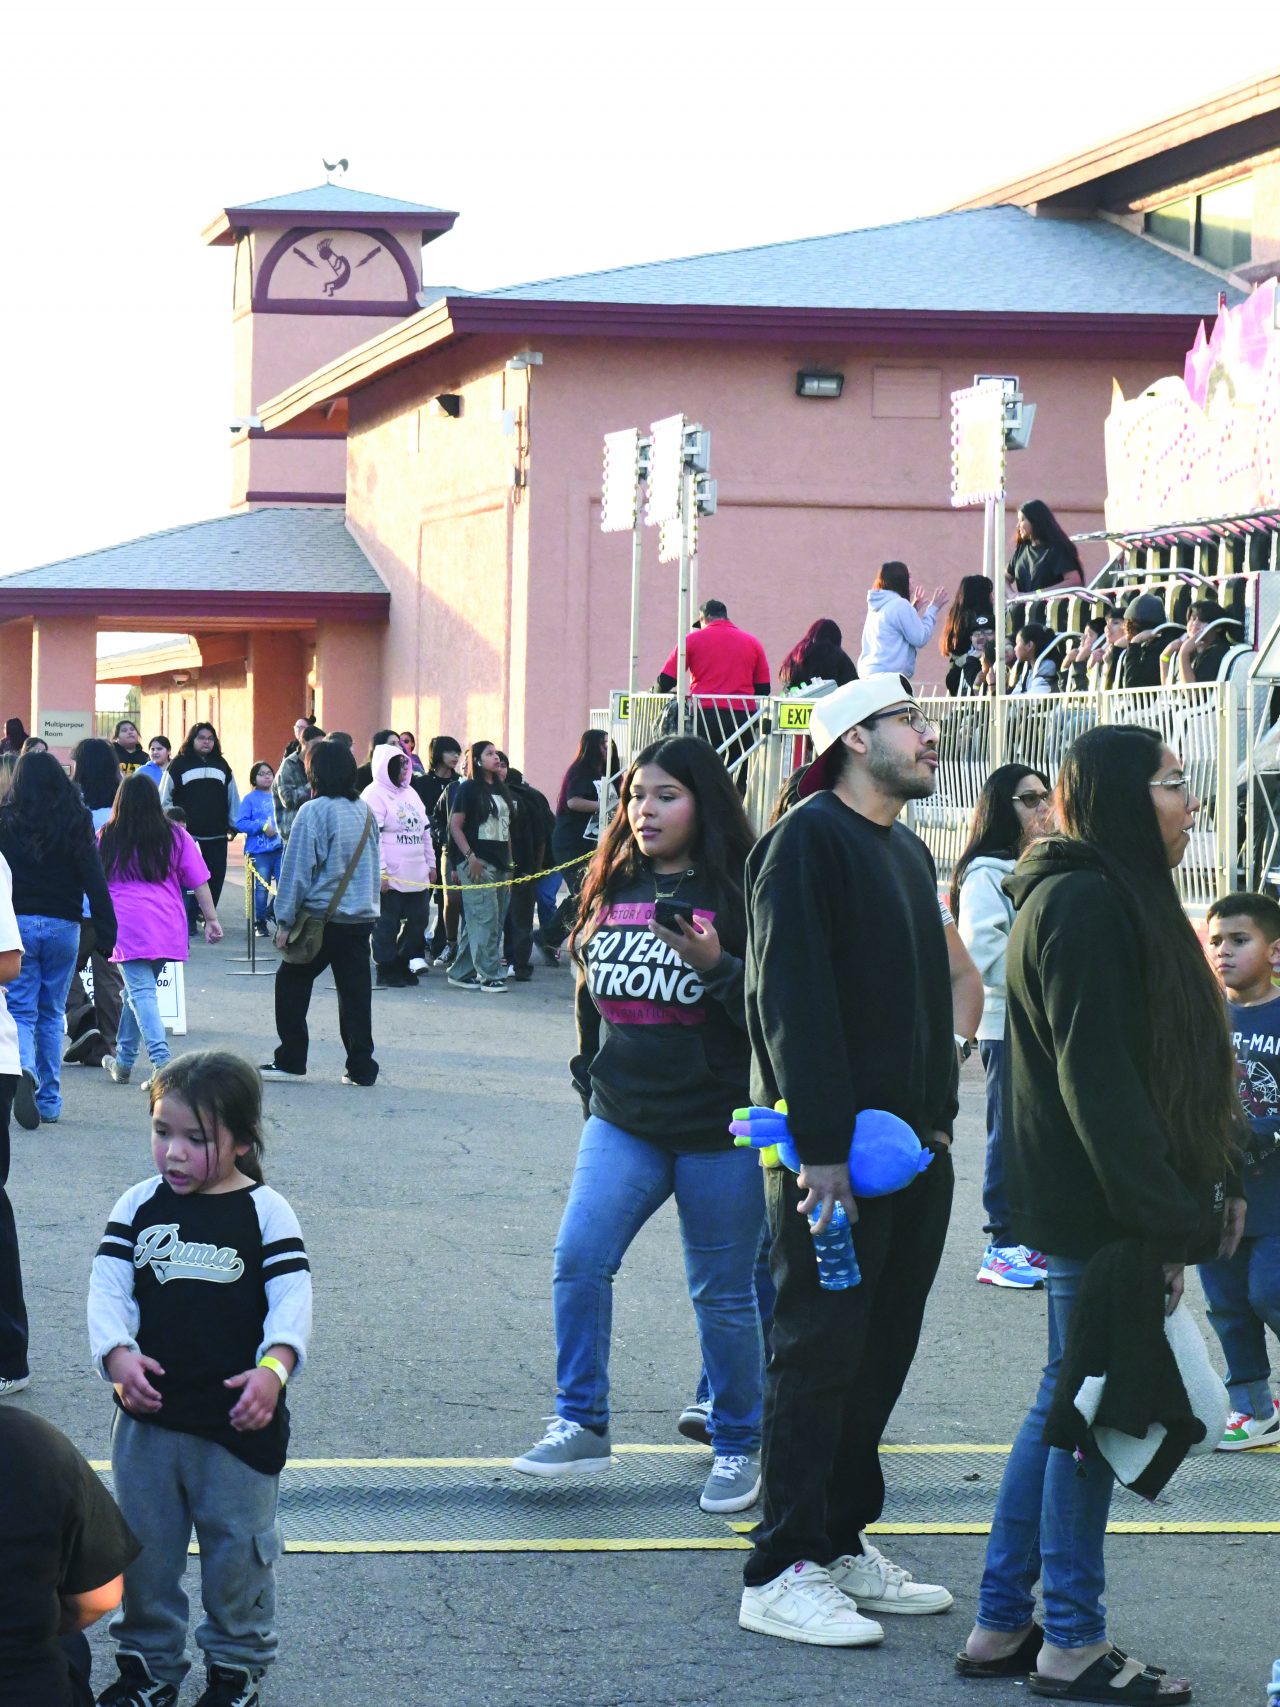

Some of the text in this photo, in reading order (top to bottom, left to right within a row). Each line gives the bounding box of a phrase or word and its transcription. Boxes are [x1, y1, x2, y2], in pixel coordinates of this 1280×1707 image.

[44, 721, 85, 729] Multipurpose
[787, 708, 813, 725] EXIT
[608, 909, 641, 920] ICTORY
[588, 931, 694, 969] 50 YEAR
[588, 962, 705, 1005] STRONG
[1231, 1031, 1280, 1056] R-MA
[133, 1223, 239, 1270] Puma
